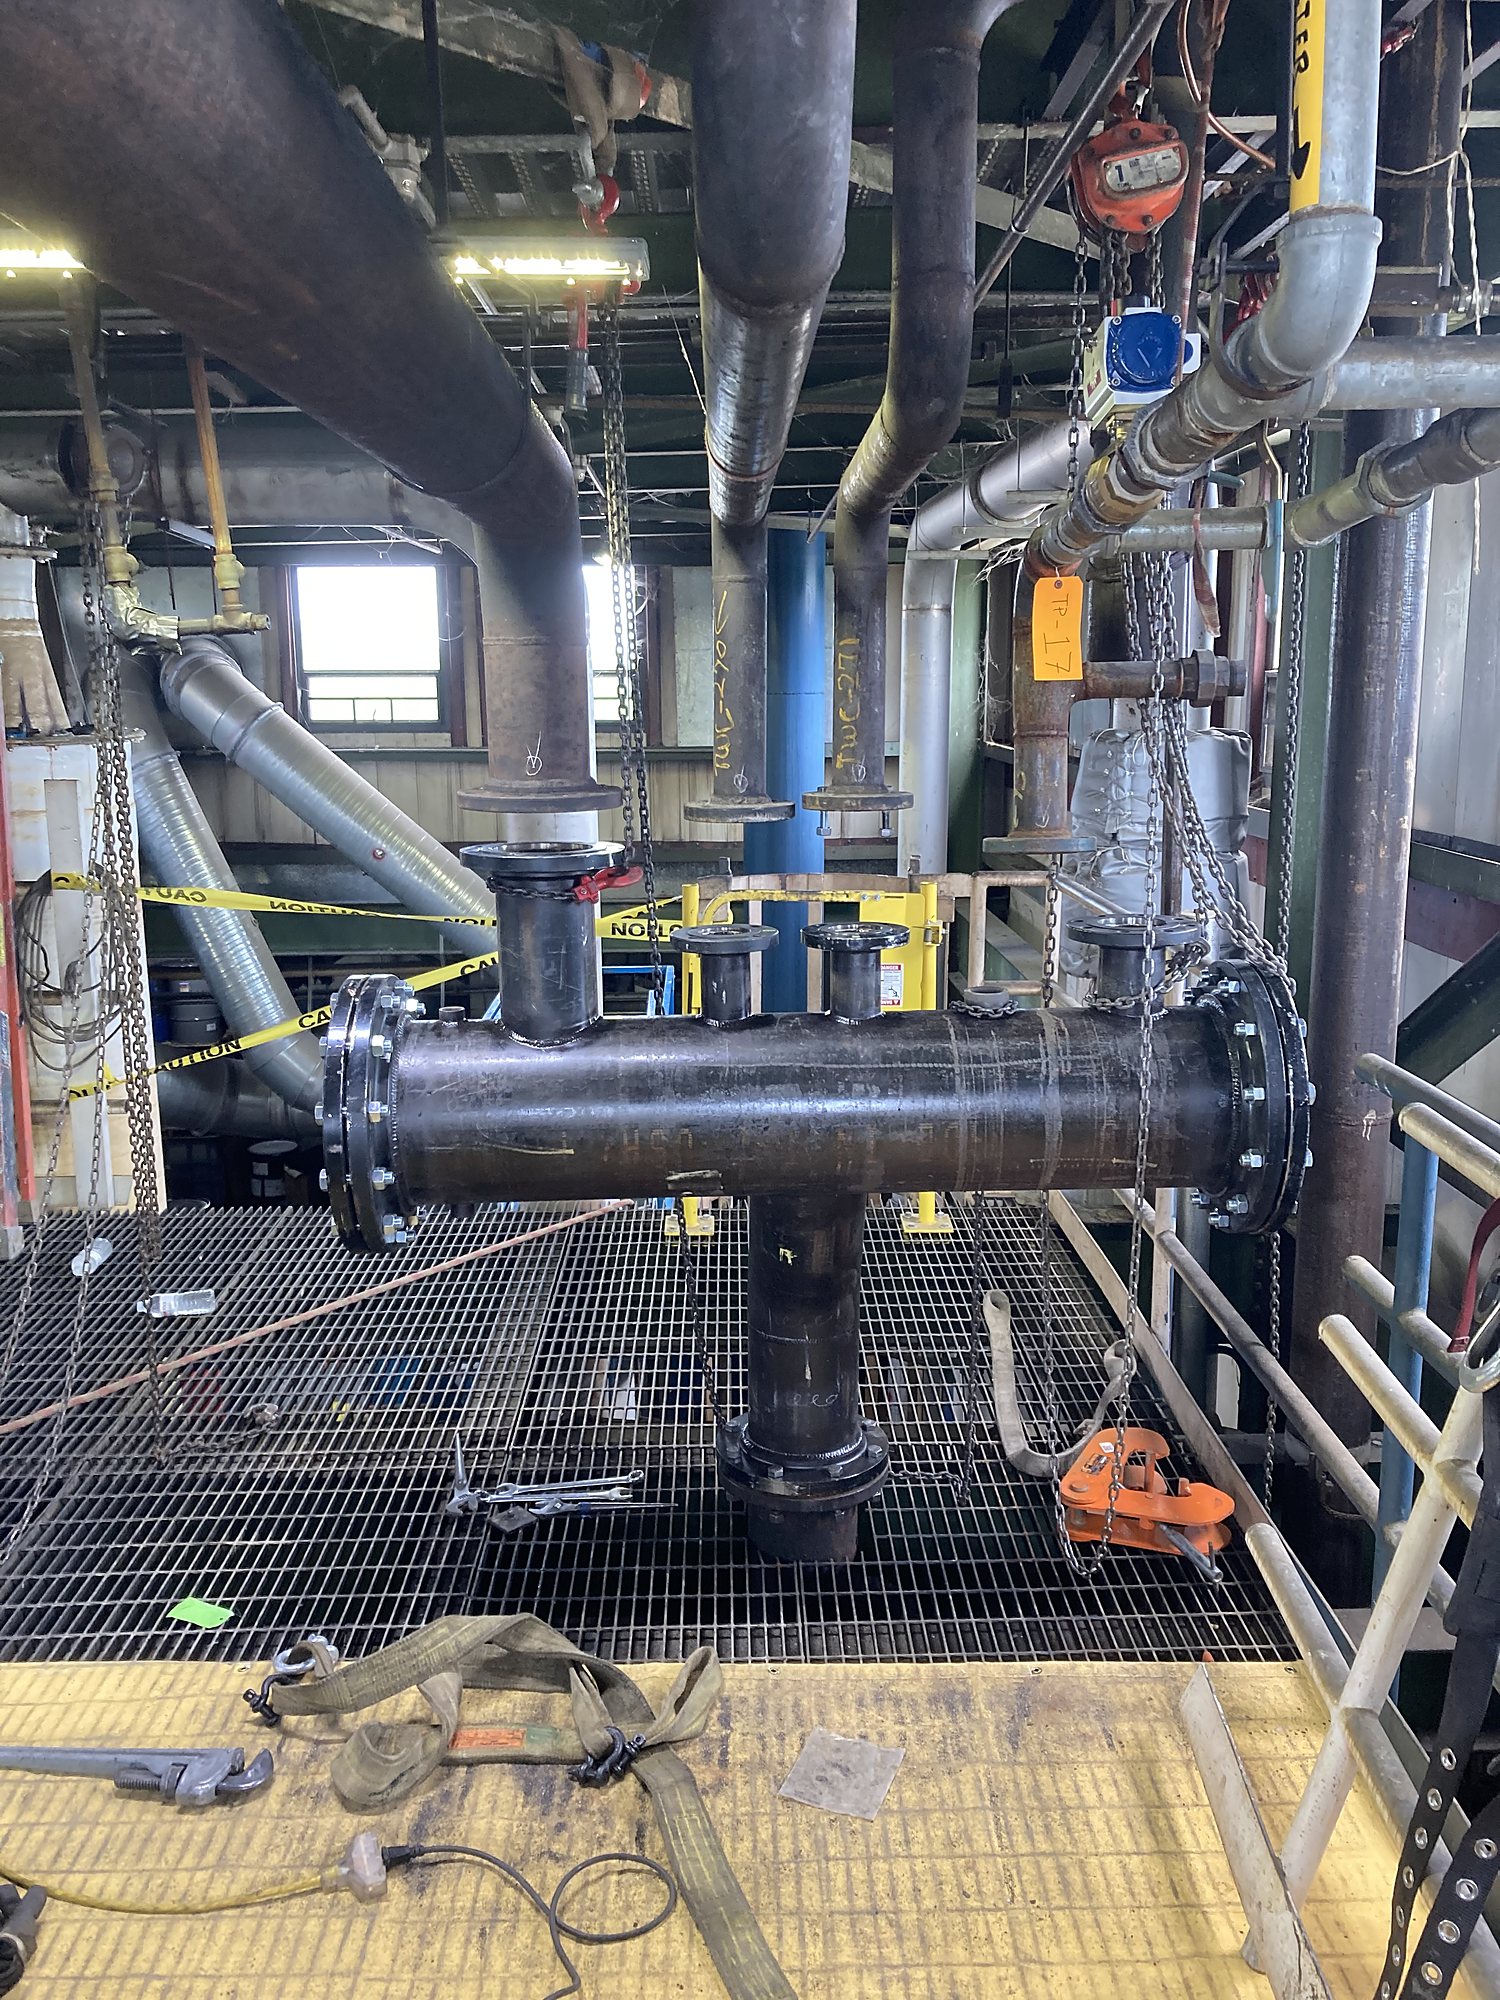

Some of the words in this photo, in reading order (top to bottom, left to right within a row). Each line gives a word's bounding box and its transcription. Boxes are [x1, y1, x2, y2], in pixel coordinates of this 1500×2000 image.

[1043, 592, 1073, 674] TP-17
[835, 638, 861, 769] TWC-271
[298, 1009, 333, 1029] CA
[153, 1038, 242, 1074] AUTION
